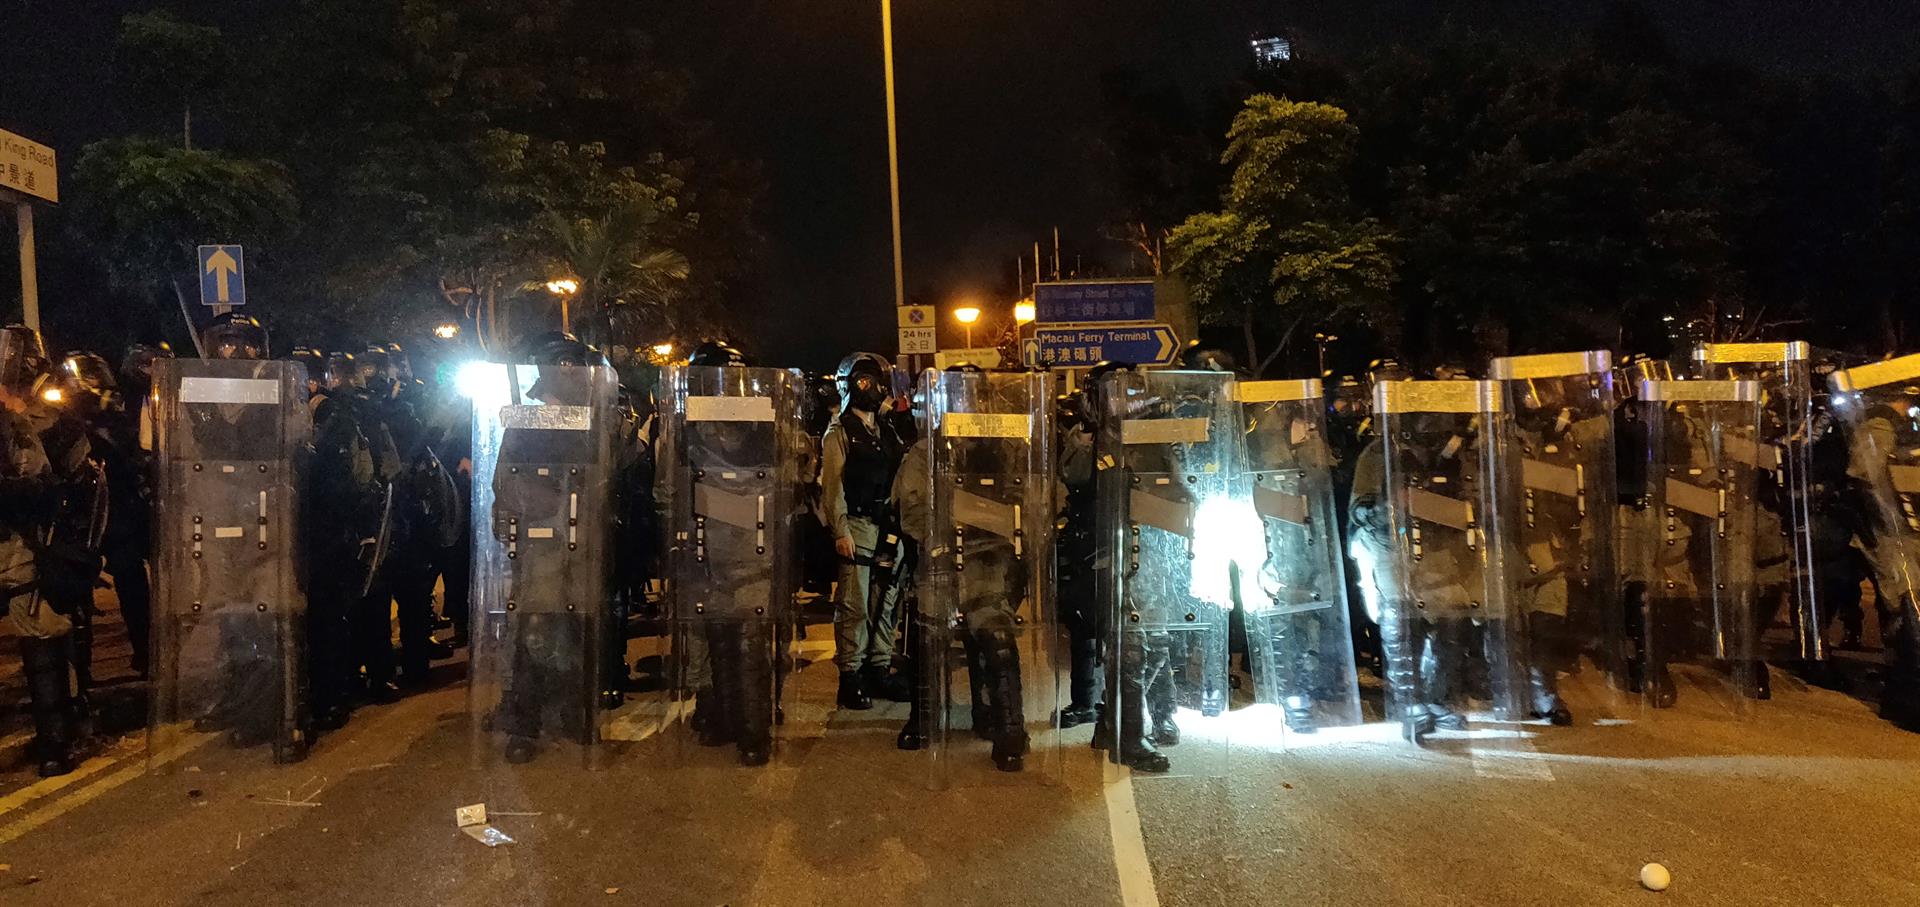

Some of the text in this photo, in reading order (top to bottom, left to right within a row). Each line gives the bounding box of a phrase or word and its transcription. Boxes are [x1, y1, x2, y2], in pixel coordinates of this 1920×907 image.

[5, 138, 27, 161] King
[28, 145, 54, 168] Road
[903, 330, 932, 338] 24 hrs
[1041, 331, 1151, 344] Macau Ferry Terminal
[907, 340, 929, 351] 全日
[1042, 346, 1102, 362] 港澳碼頭
